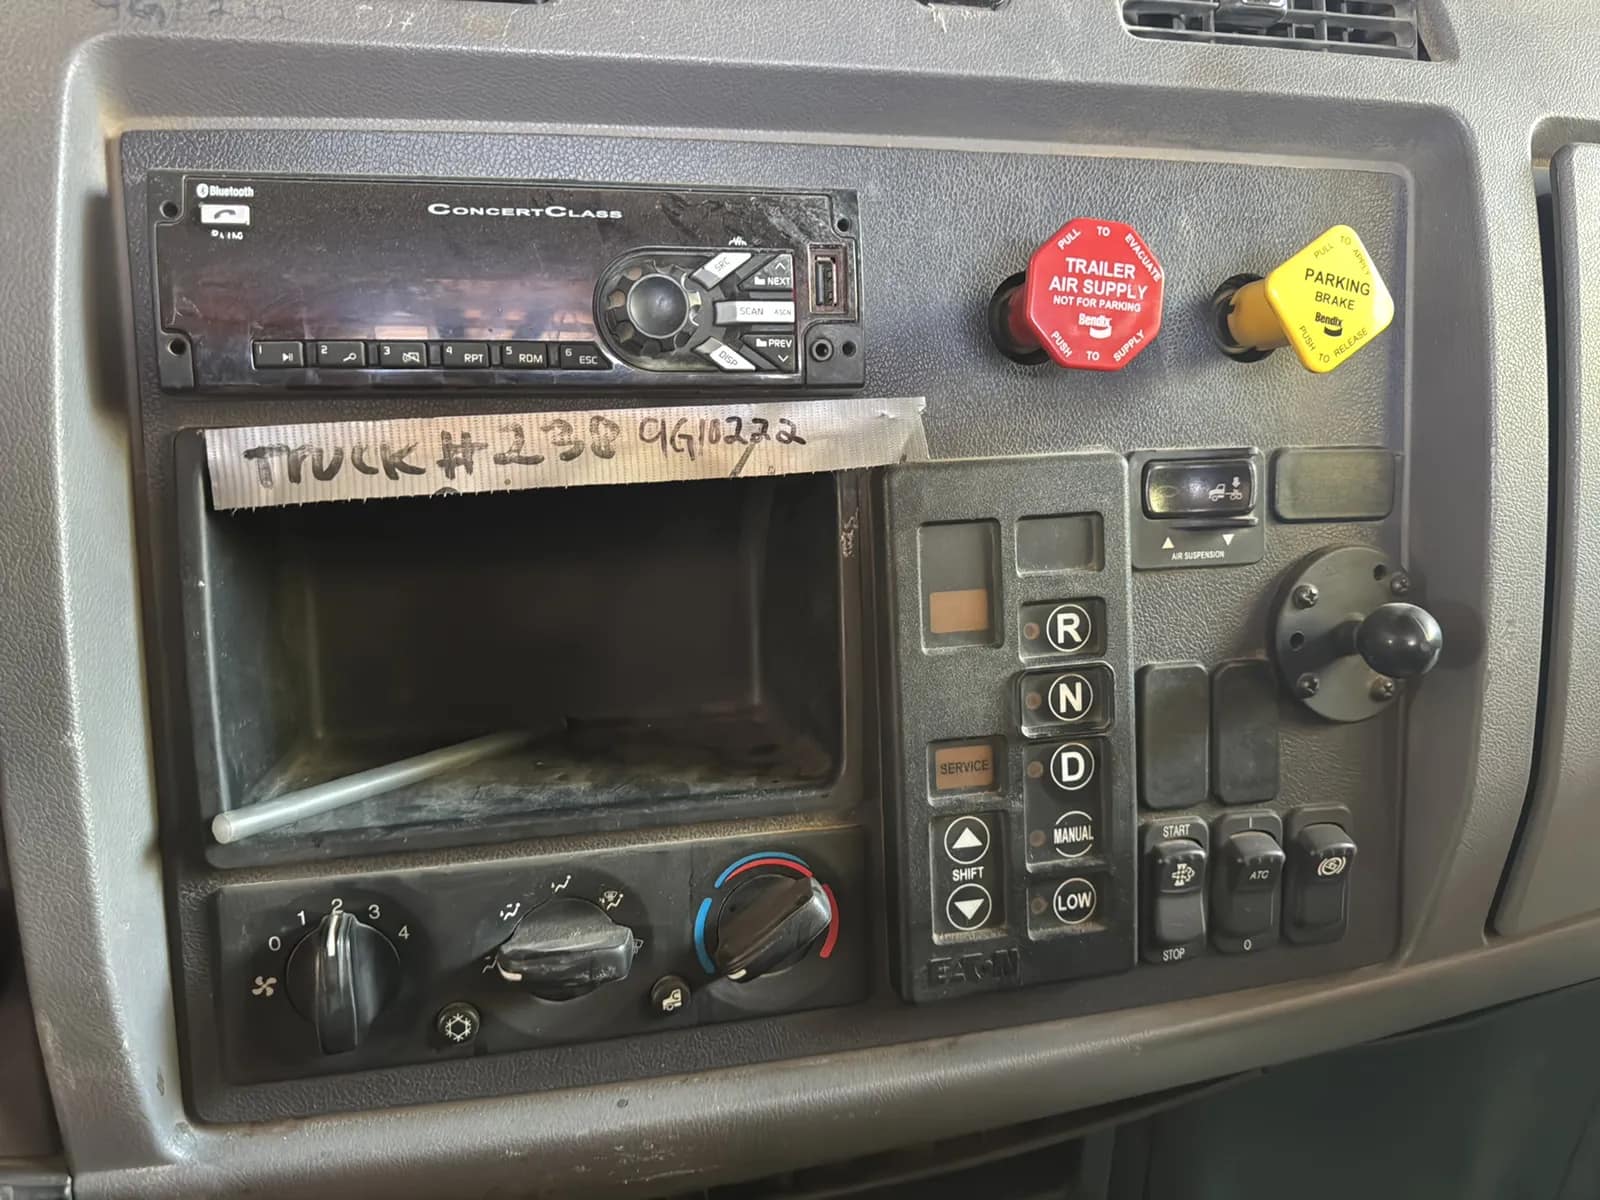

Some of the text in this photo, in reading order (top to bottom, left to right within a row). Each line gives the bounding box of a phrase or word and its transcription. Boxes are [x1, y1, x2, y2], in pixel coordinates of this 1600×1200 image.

[209, 185, 254, 197] Bluetooth
[1057, 226, 1162, 282] PULL TO EVACUATE
[1313, 243, 1334, 259] PULL
[1340, 235, 1352, 246] TO
[1065, 257, 1136, 279] TRAILER
[767, 277, 790, 286] NEXT
[1048, 276, 1148, 300] AIR SUPPLY
[1304, 267, 1371, 296] PARKING
[1053, 295, 1141, 313] NOT FOR PARKING
[1314, 291, 1356, 311] BRAKE
[740, 307, 764, 316] SCAN
[1078, 313, 1111, 327] Bendix
[1314, 312, 1344, 327] Bendix
[320, 345, 328, 354] 2
[383, 346, 391, 355] 3
[445, 346, 453, 355] 4
[505, 346, 513, 355] 5
[768, 339, 793, 348] PREV
[1050, 329, 1145, 362] PUSH TO SUPPLY
[1299, 325, 1368, 364] PUSH TO RELEASE
[464, 353, 484, 363] RPT
[565, 347, 573, 357] 6
[718, 350, 738, 366] DISP
[579, 355, 599, 365] ESC
[1171, 550, 1225, 561] AIR SUSPENSION
[1056, 612, 1083, 644] R
[1059, 681, 1083, 713] N
[939, 759, 990, 775] SERVICE
[1061, 751, 1085, 782] D
[1053, 824, 1095, 844] MANUAL
[1162, 824, 1191, 838] START
[952, 866, 984, 882] SHIFT
[1249, 870, 1270, 880] ATC
[331, 898, 344, 914] 2
[1057, 892, 1092, 912] LOW
[296, 910, 306, 926] 1
[368, 904, 381, 919] 3
[398, 925, 410, 940] 4
[1162, 948, 1185, 962] STOP
